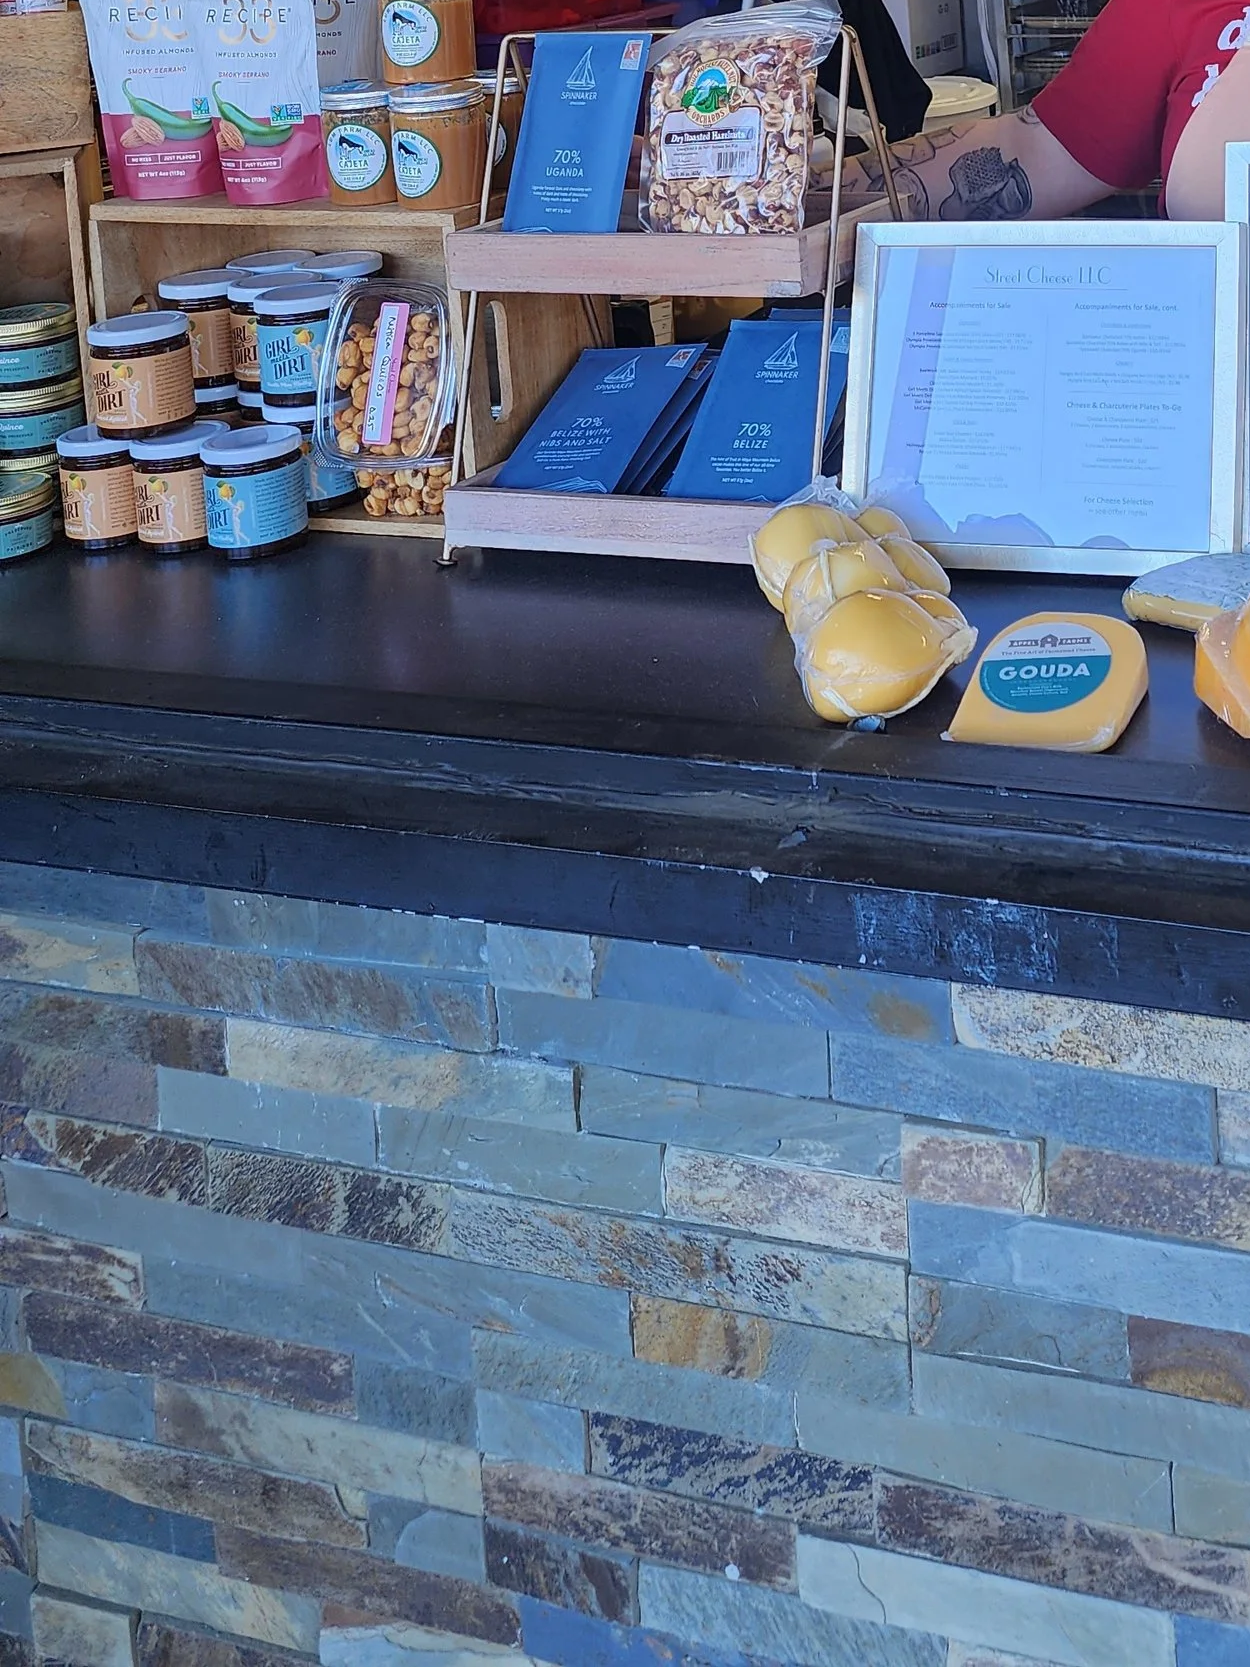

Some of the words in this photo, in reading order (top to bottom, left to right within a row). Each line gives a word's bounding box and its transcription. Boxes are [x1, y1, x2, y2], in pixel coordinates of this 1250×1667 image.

[206, 8, 287, 24] RECIPE
[392, 36, 420, 44] CAJETA
[560, 91, 598, 101] SPINNAKER
[691, 110, 725, 124] ORCHARDS
[671, 134, 684, 143] Dry
[684, 132, 711, 142] Roasted
[553, 149, 582, 164] 70%
[338, 159, 369, 169] CAJETA
[398, 166, 422, 175] CAJETA
[545, 166, 584, 178] UGANDA
[984, 265, 1022, 284] Street
[1027, 265, 1073, 285] Cheese
[1078, 265, 1112, 285] LLC
[929, 301, 986, 310] Accompaniments
[987, 301, 996, 309] for
[997, 301, 1011, 309] Sale
[1074, 302, 1132, 312] Accompaniments
[1133, 303, 1143, 311] for
[265, 336, 300, 360] GIRL
[273, 352, 308, 380] DIRT
[755, 370, 799, 379] SPINNAKER
[593, 382, 635, 391] SPINNAKER
[97, 389, 126, 413] DIRT
[1066, 401, 1090, 409] Cheese
[1099, 402, 1138, 410] Charcuterie
[1140, 403, 1160, 411] Plates
[571, 417, 605, 428] 70%
[550, 429, 585, 438] BELIZE
[585, 427, 612, 435] WITH
[737, 423, 772, 437] 70%
[539, 439, 562, 448] NIBS
[562, 439, 586, 447] AND
[587, 436, 612, 445] SALT
[733, 439, 769, 449] BELIZE
[1084, 496, 1095, 504] For
[1122, 497, 1154, 506] Selection
[999, 663, 1091, 681] GOUDA
